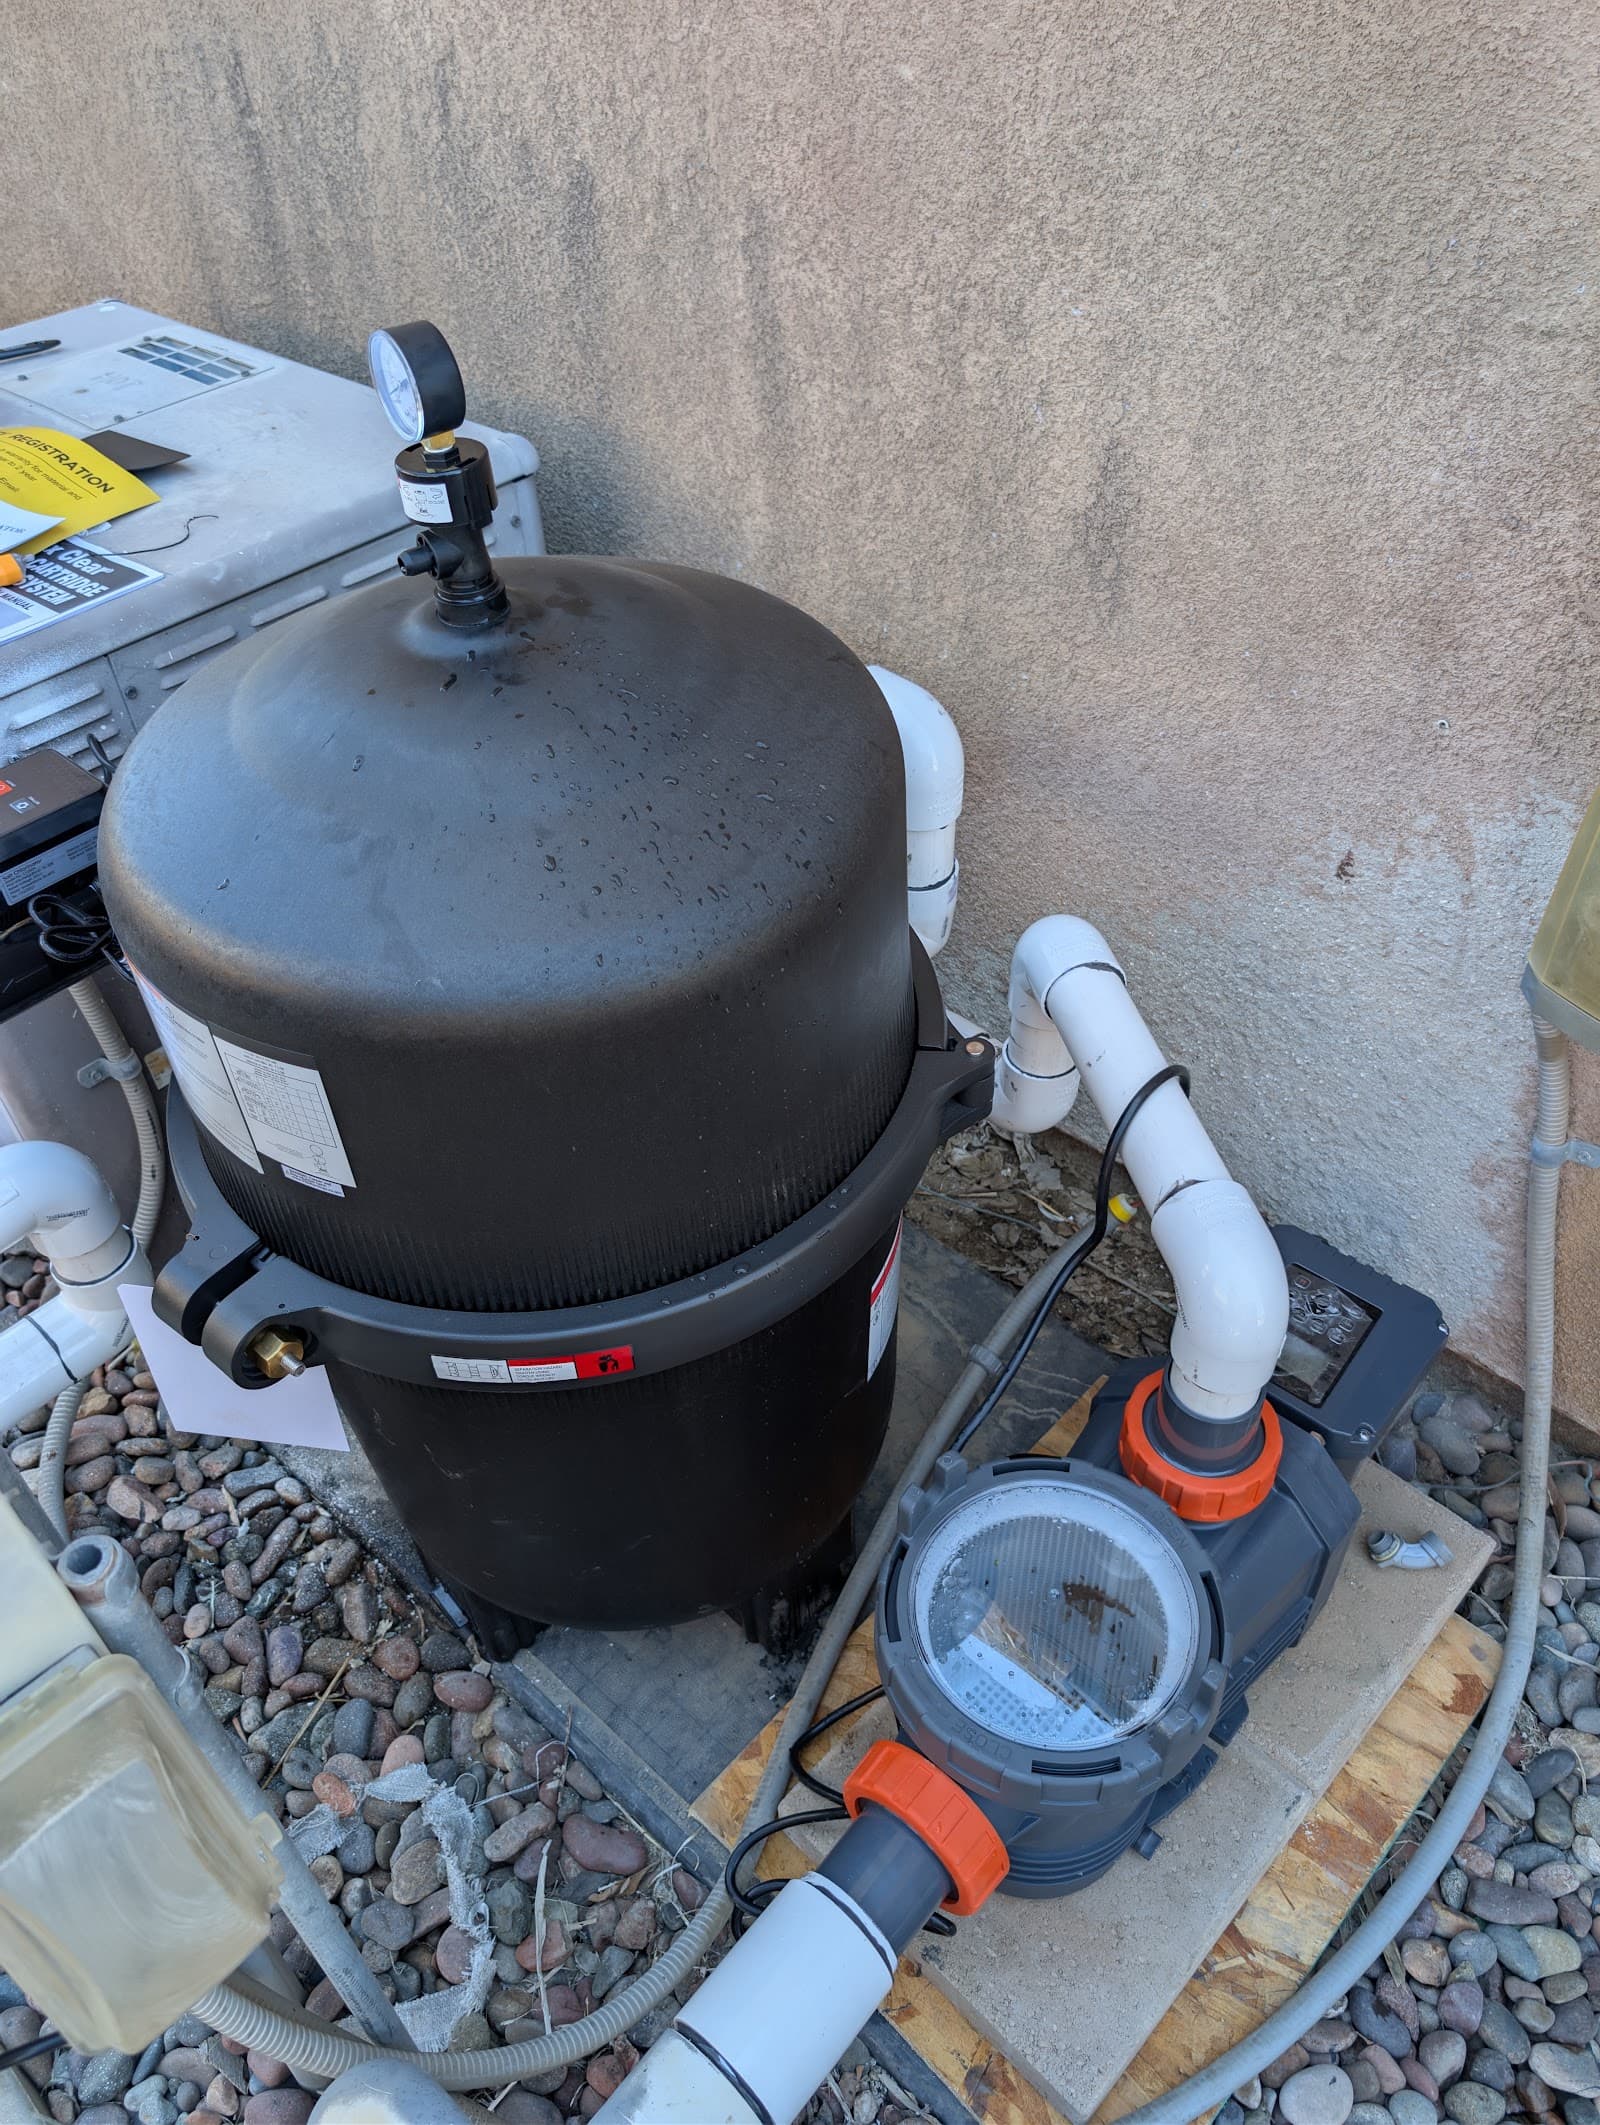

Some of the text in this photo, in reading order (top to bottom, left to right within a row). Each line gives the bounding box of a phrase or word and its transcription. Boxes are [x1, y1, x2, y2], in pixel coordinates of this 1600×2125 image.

[9, 434, 115, 493] REGISTRATION
[31, 464, 43, 473] for
[58, 549, 114, 575] Clear
[20, 575, 77, 606] SYSTEM
[26, 558, 110, 598] CARTRIDGE
